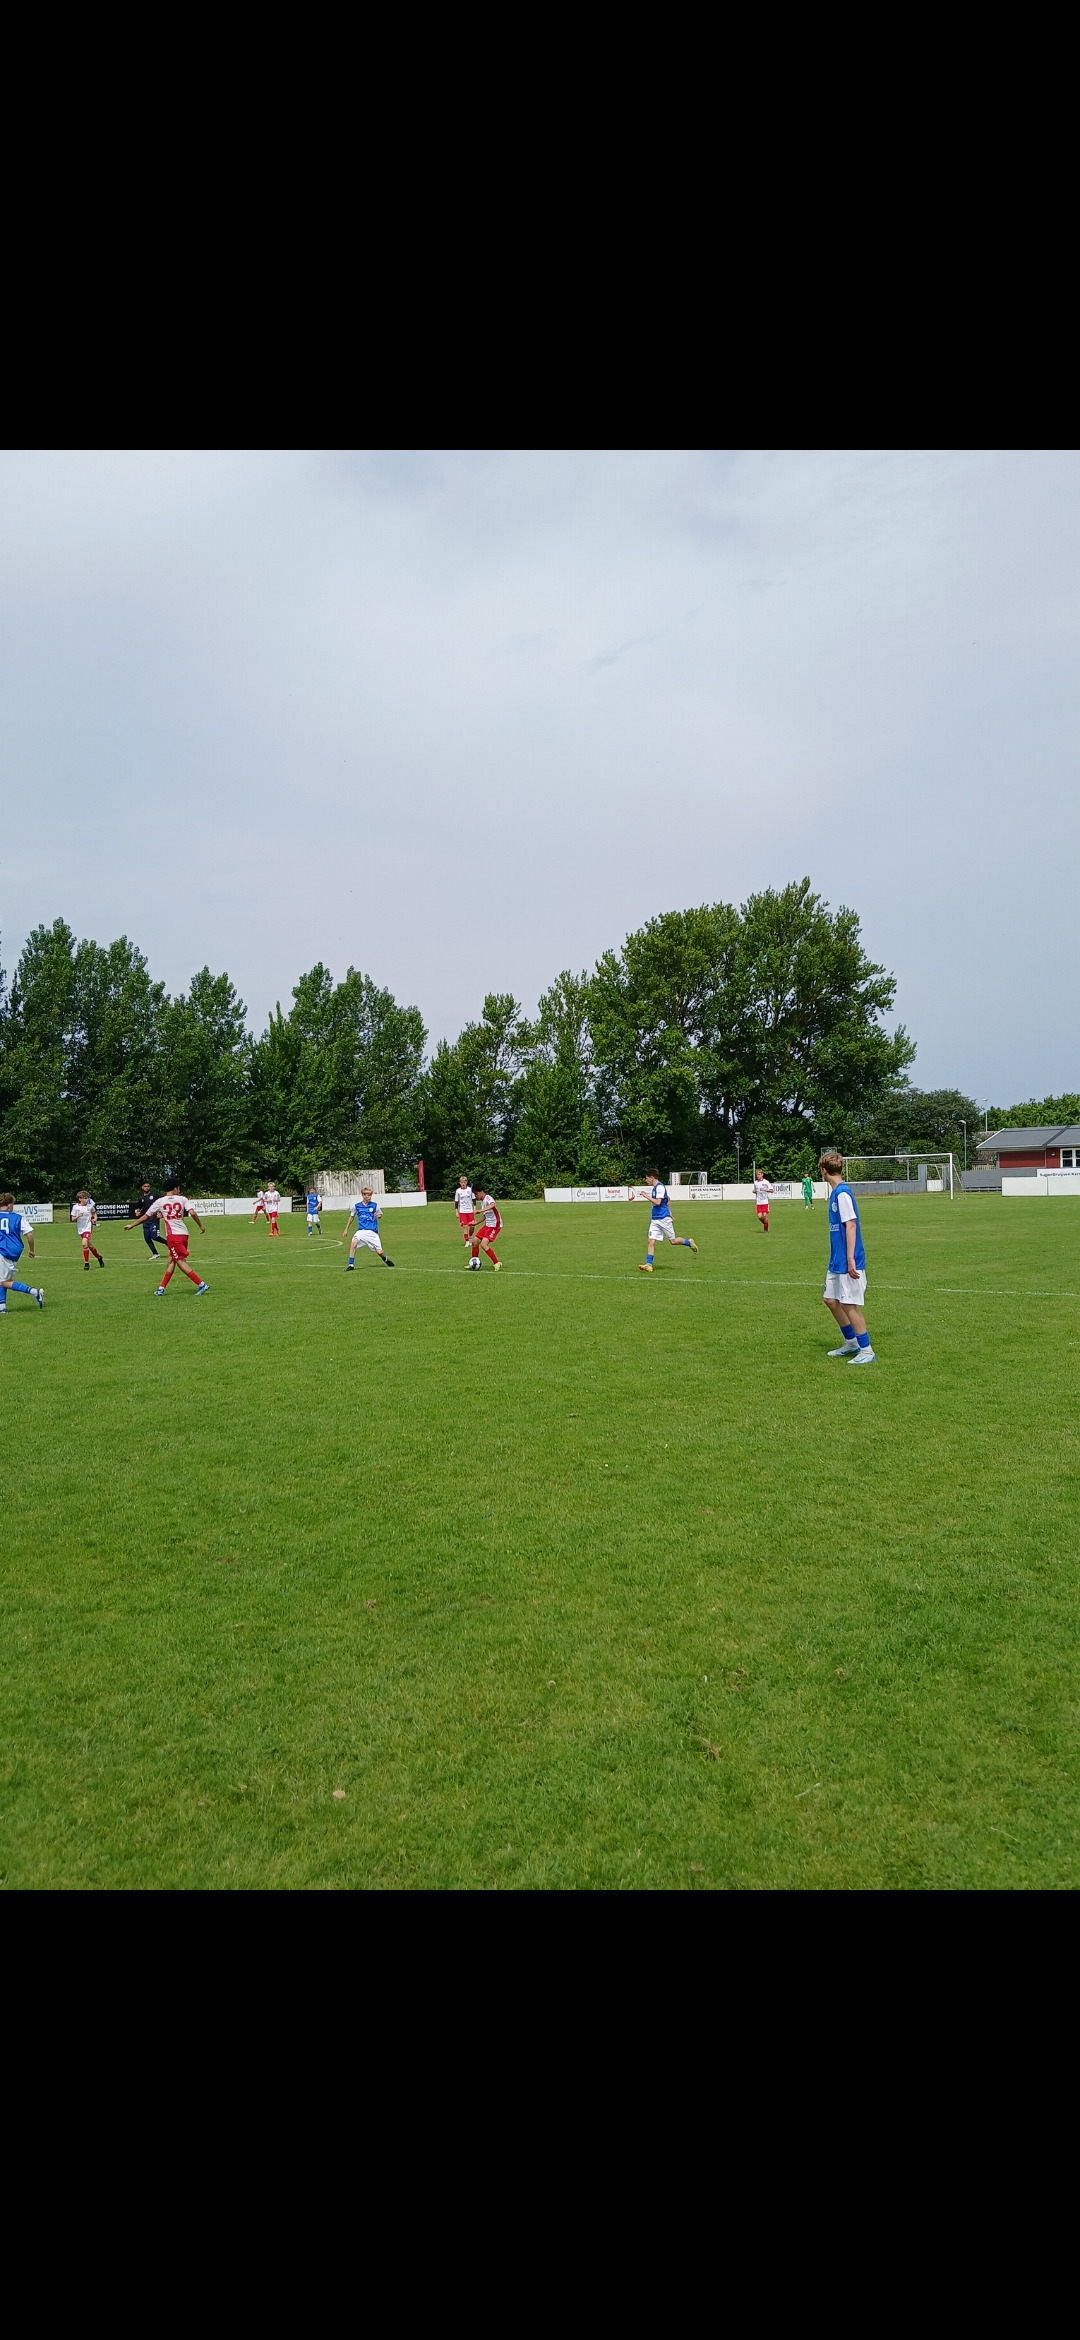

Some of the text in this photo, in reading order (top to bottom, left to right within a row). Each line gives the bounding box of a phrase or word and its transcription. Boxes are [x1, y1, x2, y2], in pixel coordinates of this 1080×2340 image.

[23, 1205, 38, 1215] VVS
[162, 1202, 183, 1220] 22
[0, 1217, 10, 1235] 9
